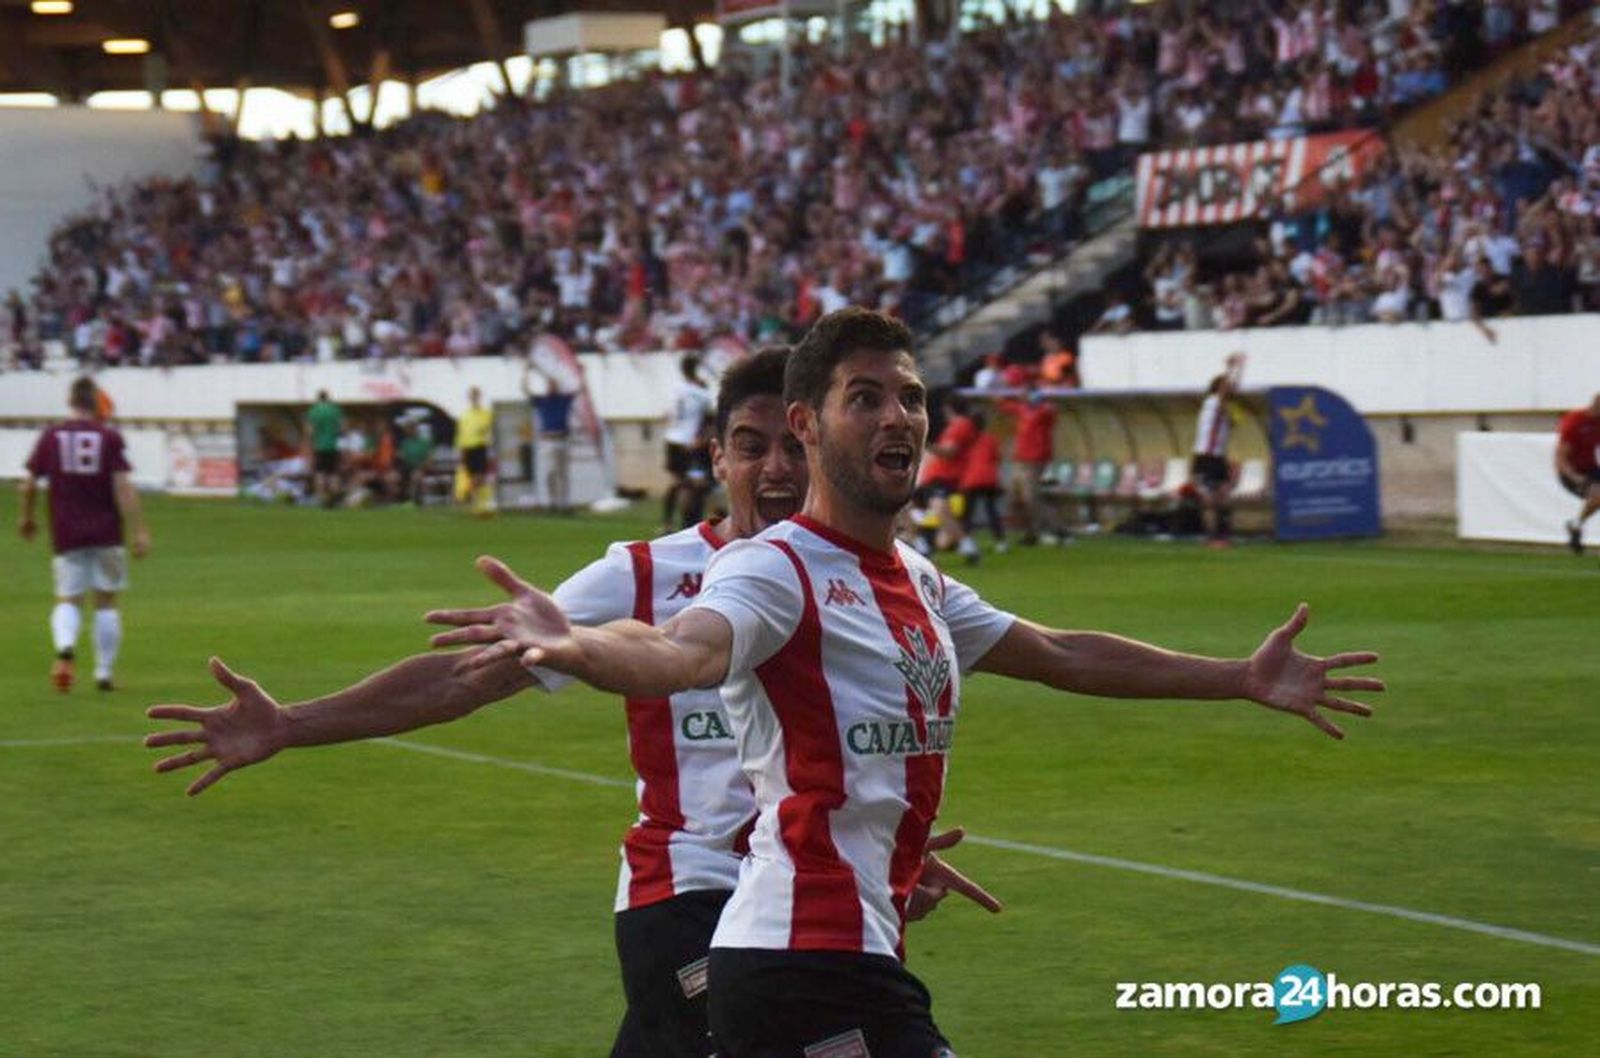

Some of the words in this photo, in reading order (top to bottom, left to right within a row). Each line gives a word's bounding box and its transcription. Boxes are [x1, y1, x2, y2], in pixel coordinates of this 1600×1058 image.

[55, 430, 103, 474] 18
[682, 711, 735, 741] CA
[847, 721, 921, 754] CAJA
